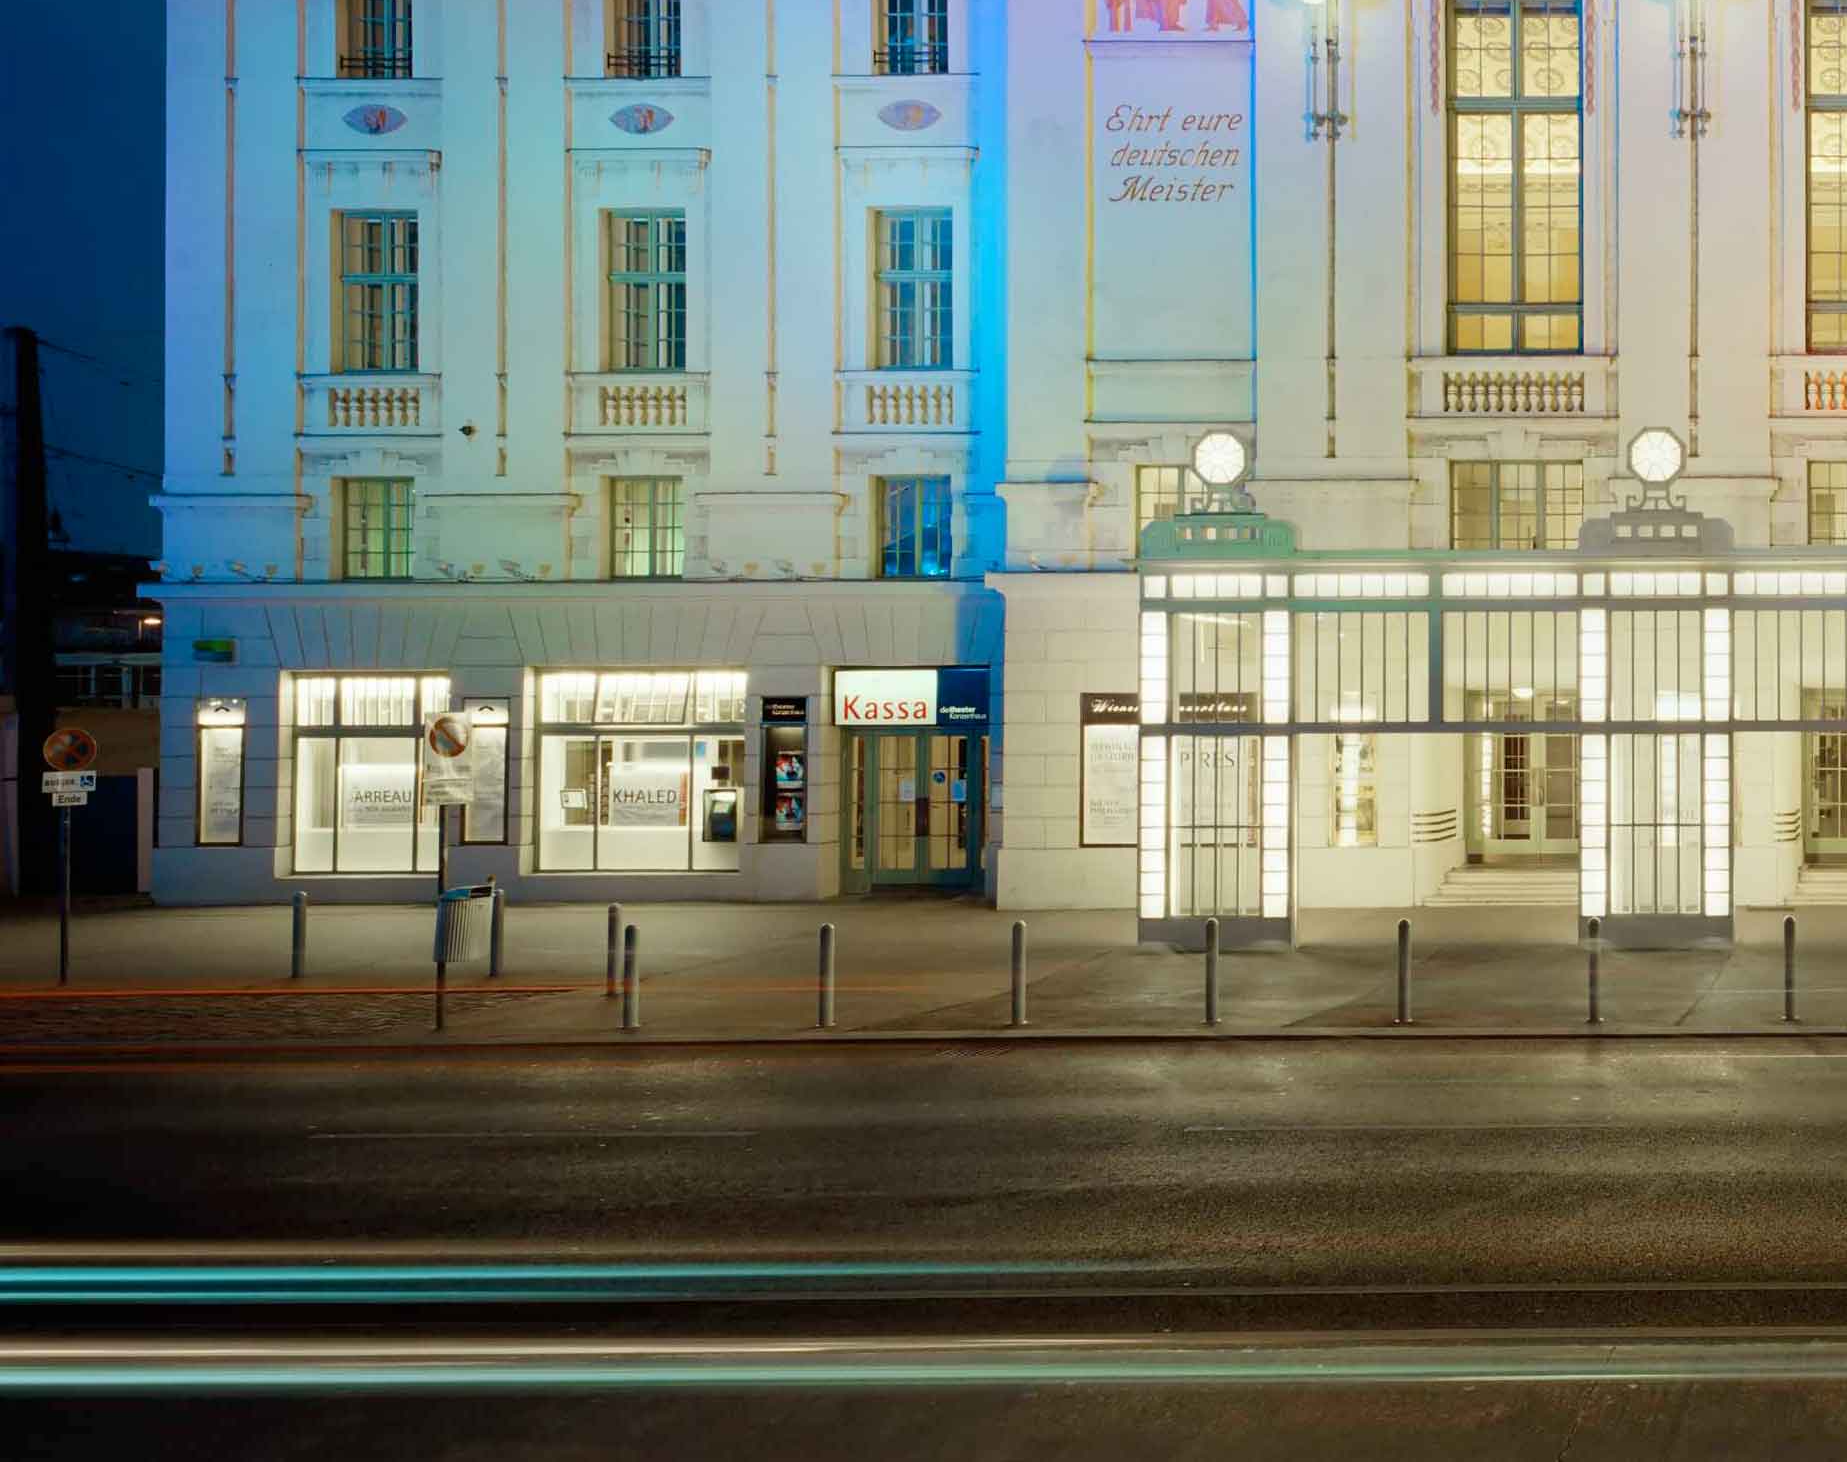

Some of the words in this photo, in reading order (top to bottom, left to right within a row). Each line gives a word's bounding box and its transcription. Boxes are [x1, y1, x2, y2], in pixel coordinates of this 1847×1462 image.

[1105, 104, 1173, 132] Ehrt
[1181, 113, 1243, 132] eure
[1110, 140, 1240, 167] deutschen
[1109, 175, 1234, 202] Meister
[844, 694, 927, 720] Kassa
[57, 793, 81, 804] Ende
[351, 789, 412, 803] ARREAU
[613, 789, 677, 804] KHALED
